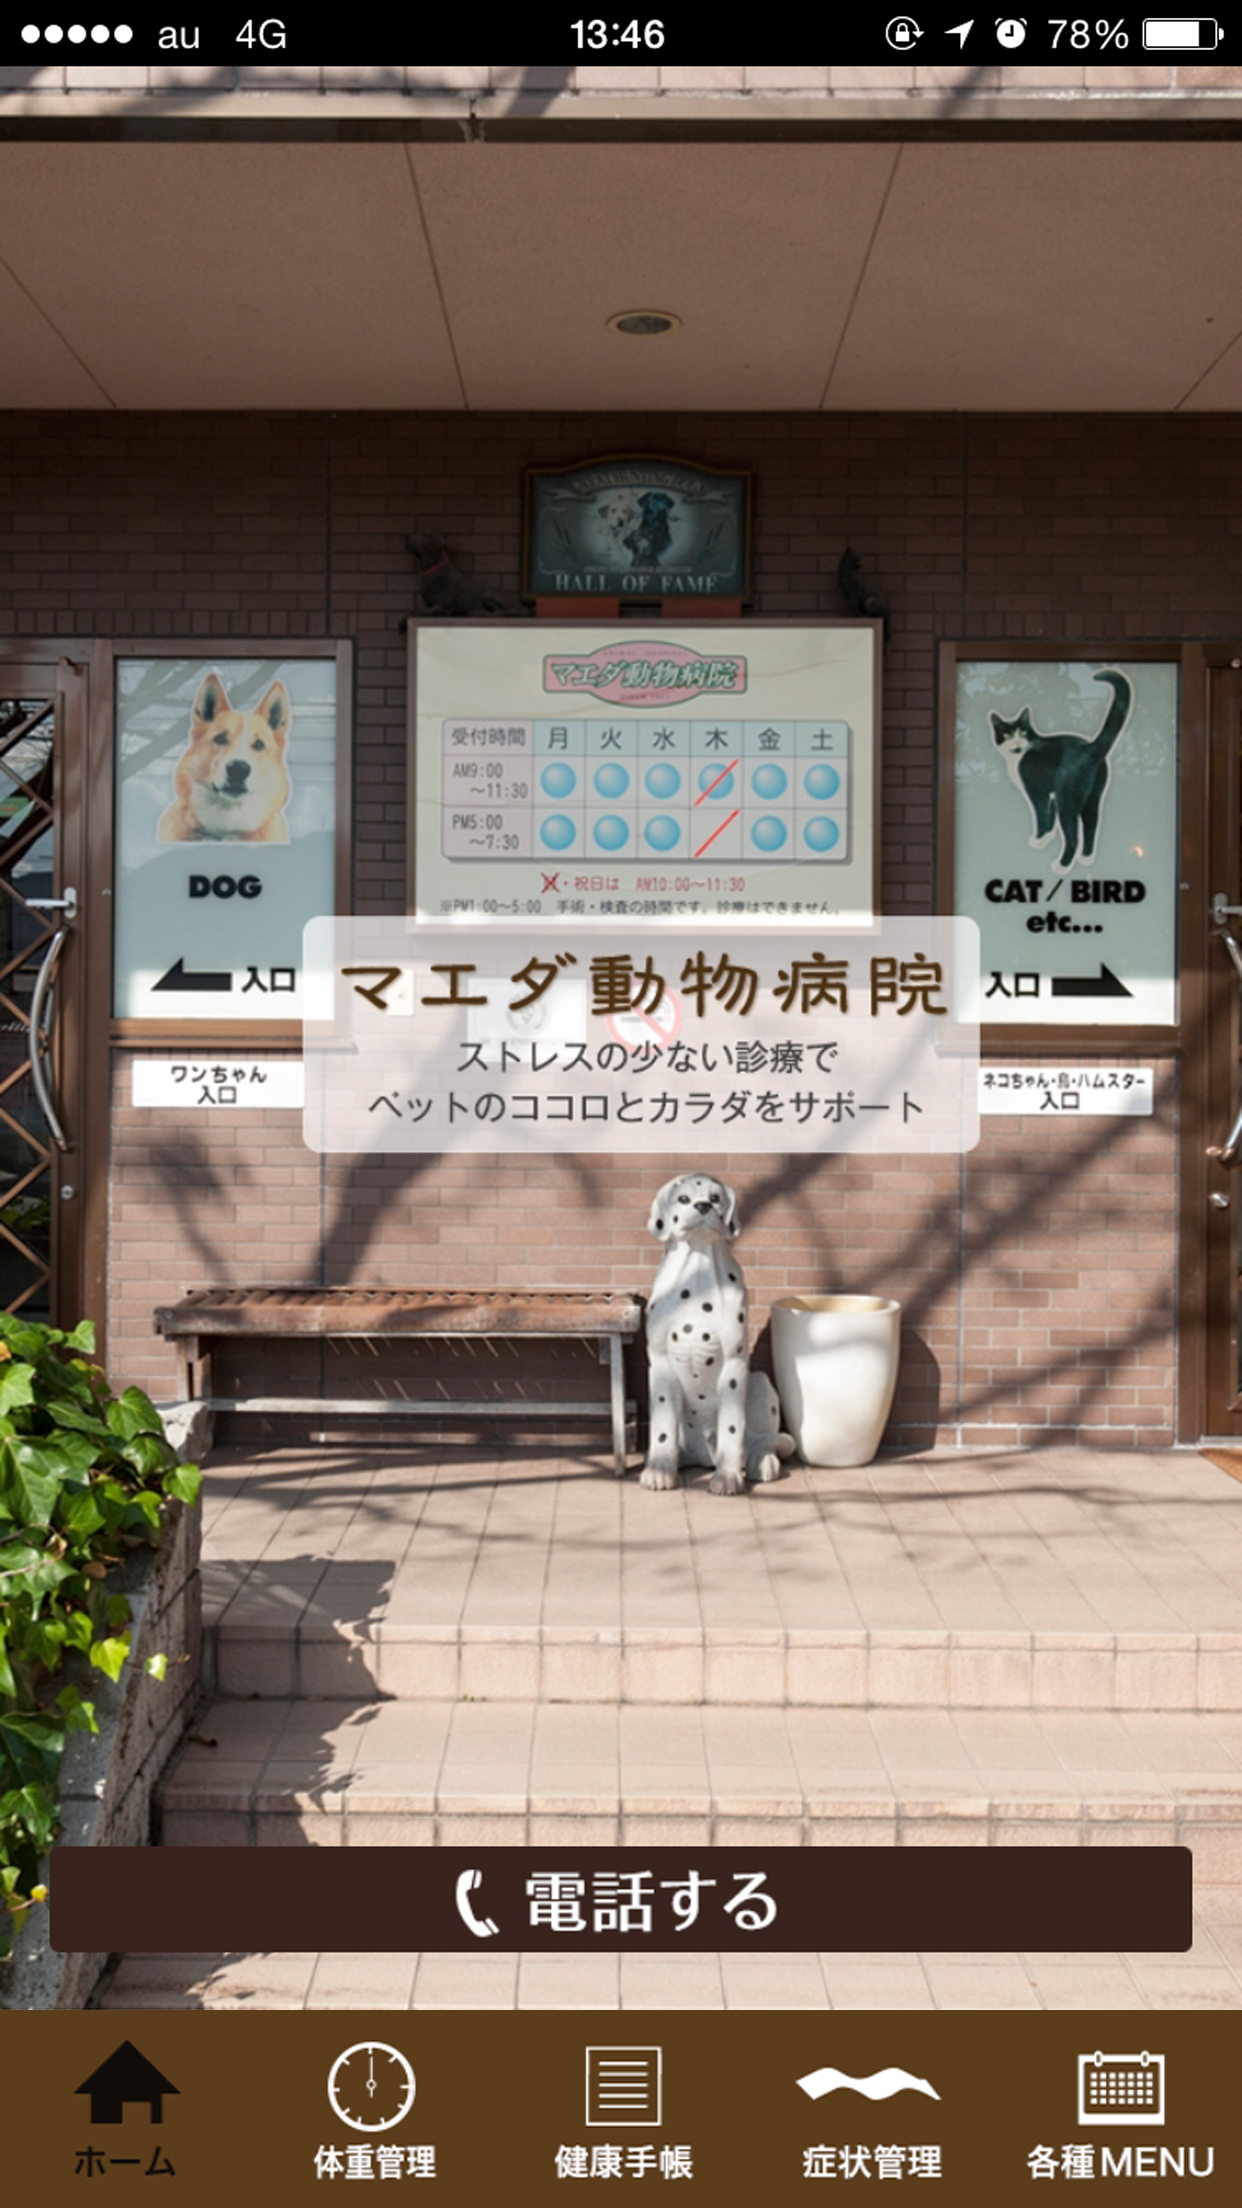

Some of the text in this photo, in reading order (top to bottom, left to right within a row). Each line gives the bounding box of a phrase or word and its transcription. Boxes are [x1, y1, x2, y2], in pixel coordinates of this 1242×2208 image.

[554, 573, 720, 594] HALL OF FAME
[550, 659, 739, 689] マエダ動物病院
[451, 726, 834, 751] 受付時間 月 火 水 木 金 土
[452, 762, 503, 778] AM9:00
[452, 813, 503, 830] PM5:00
[188, 874, 263, 900] DOG
[241, 966, 296, 993] 入口
[985, 971, 1040, 998] 入口
[171, 1065, 267, 1083] ワンちゃん
[197, 1086, 237, 1105] 入口
[1039, 1091, 1080, 1111] 入口
